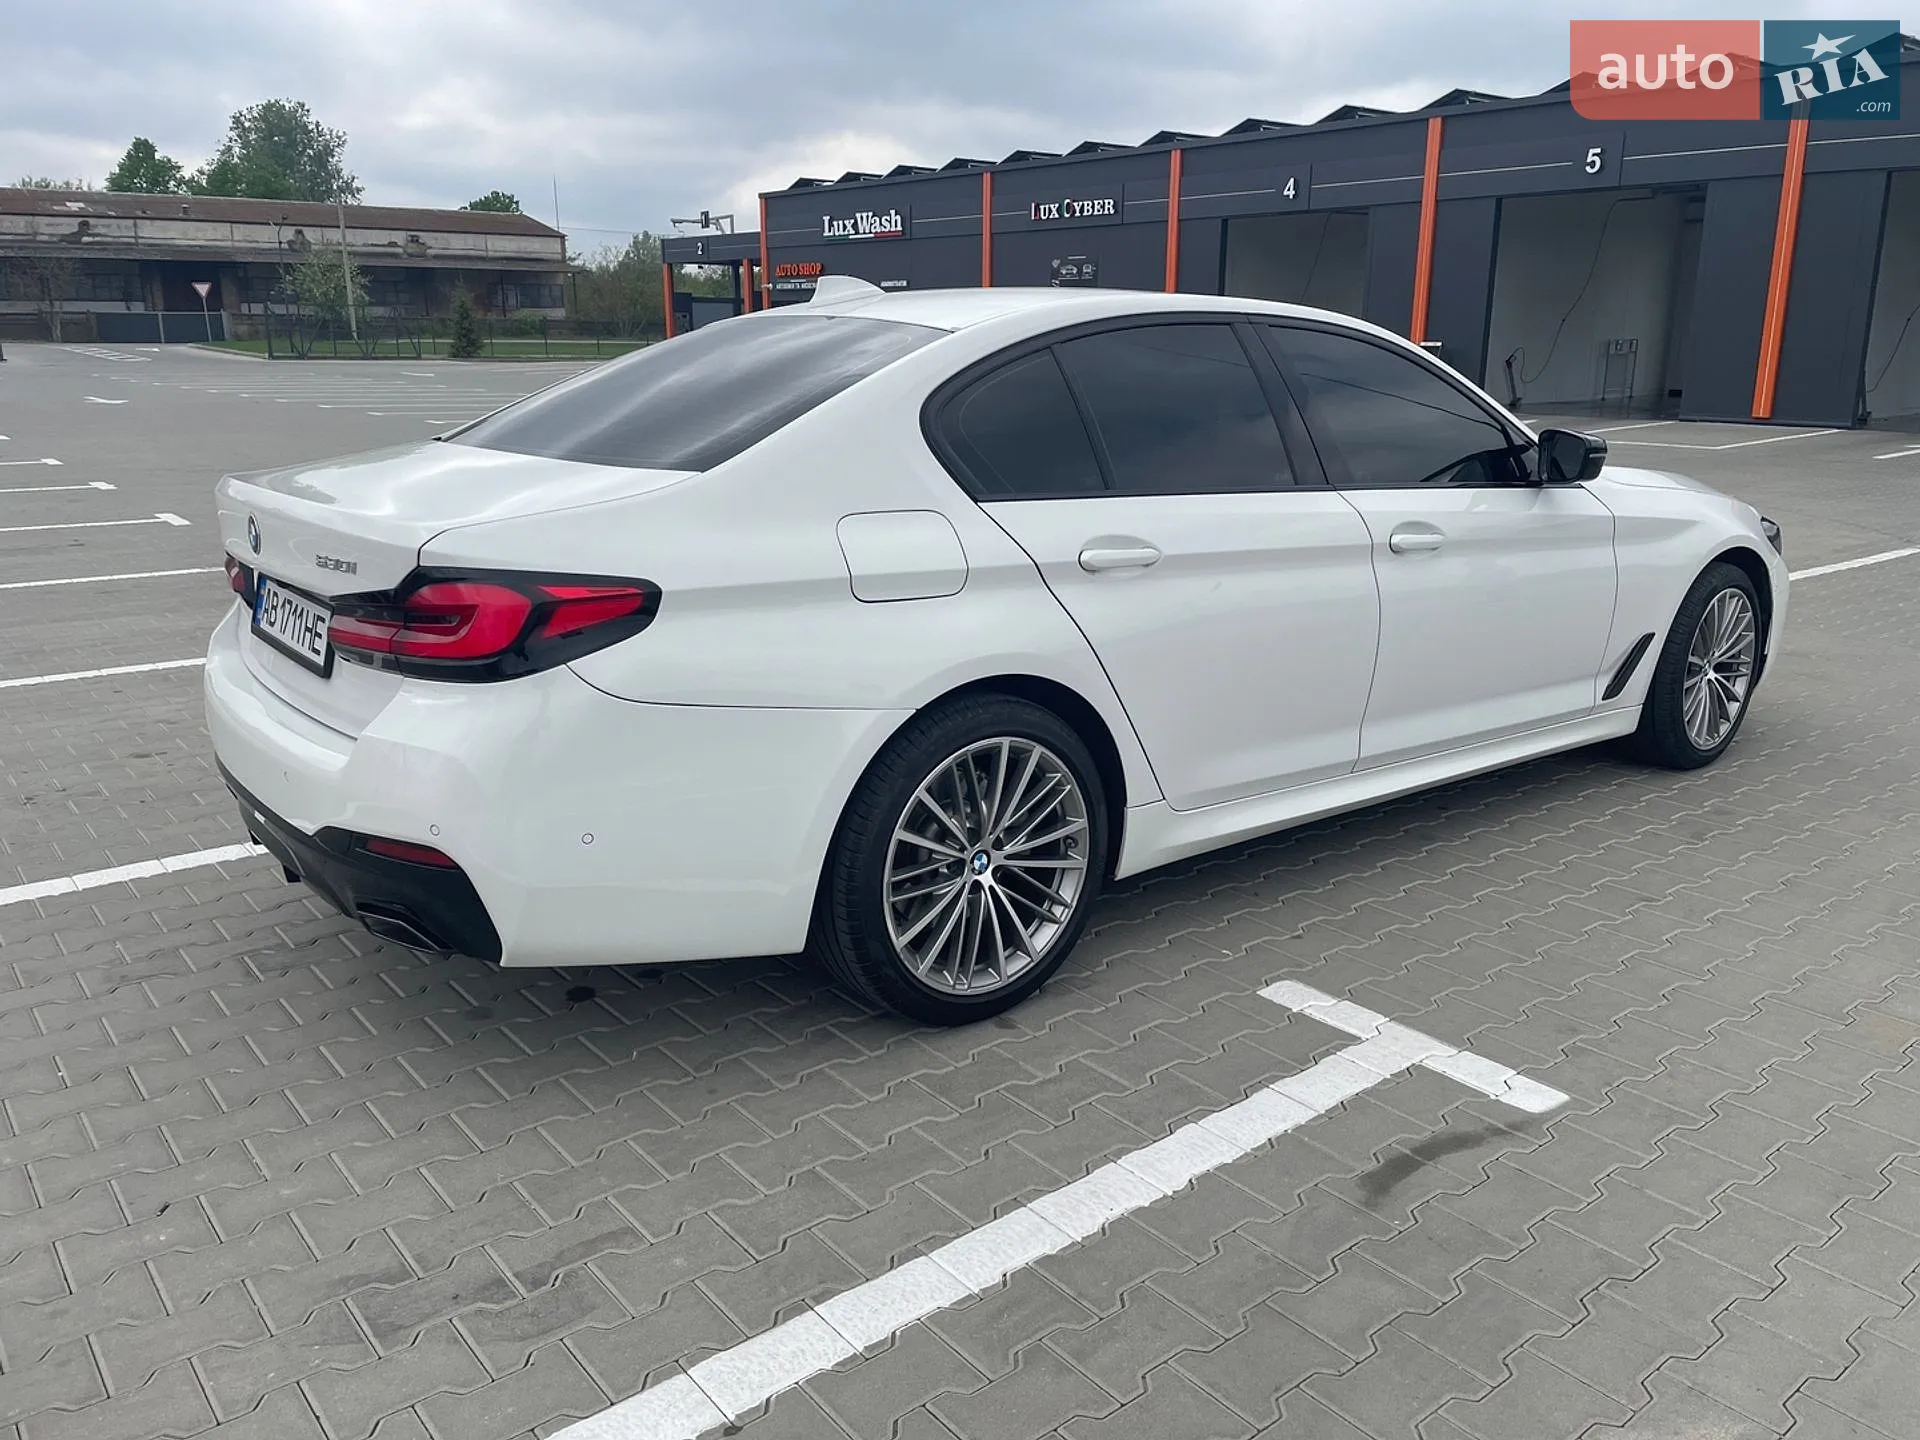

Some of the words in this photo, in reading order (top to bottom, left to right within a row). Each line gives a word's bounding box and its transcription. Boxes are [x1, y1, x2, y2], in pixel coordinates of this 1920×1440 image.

[1585, 148, 1601, 174] 5
[1283, 177, 1296, 199] 4
[697, 242, 703, 255] 2
